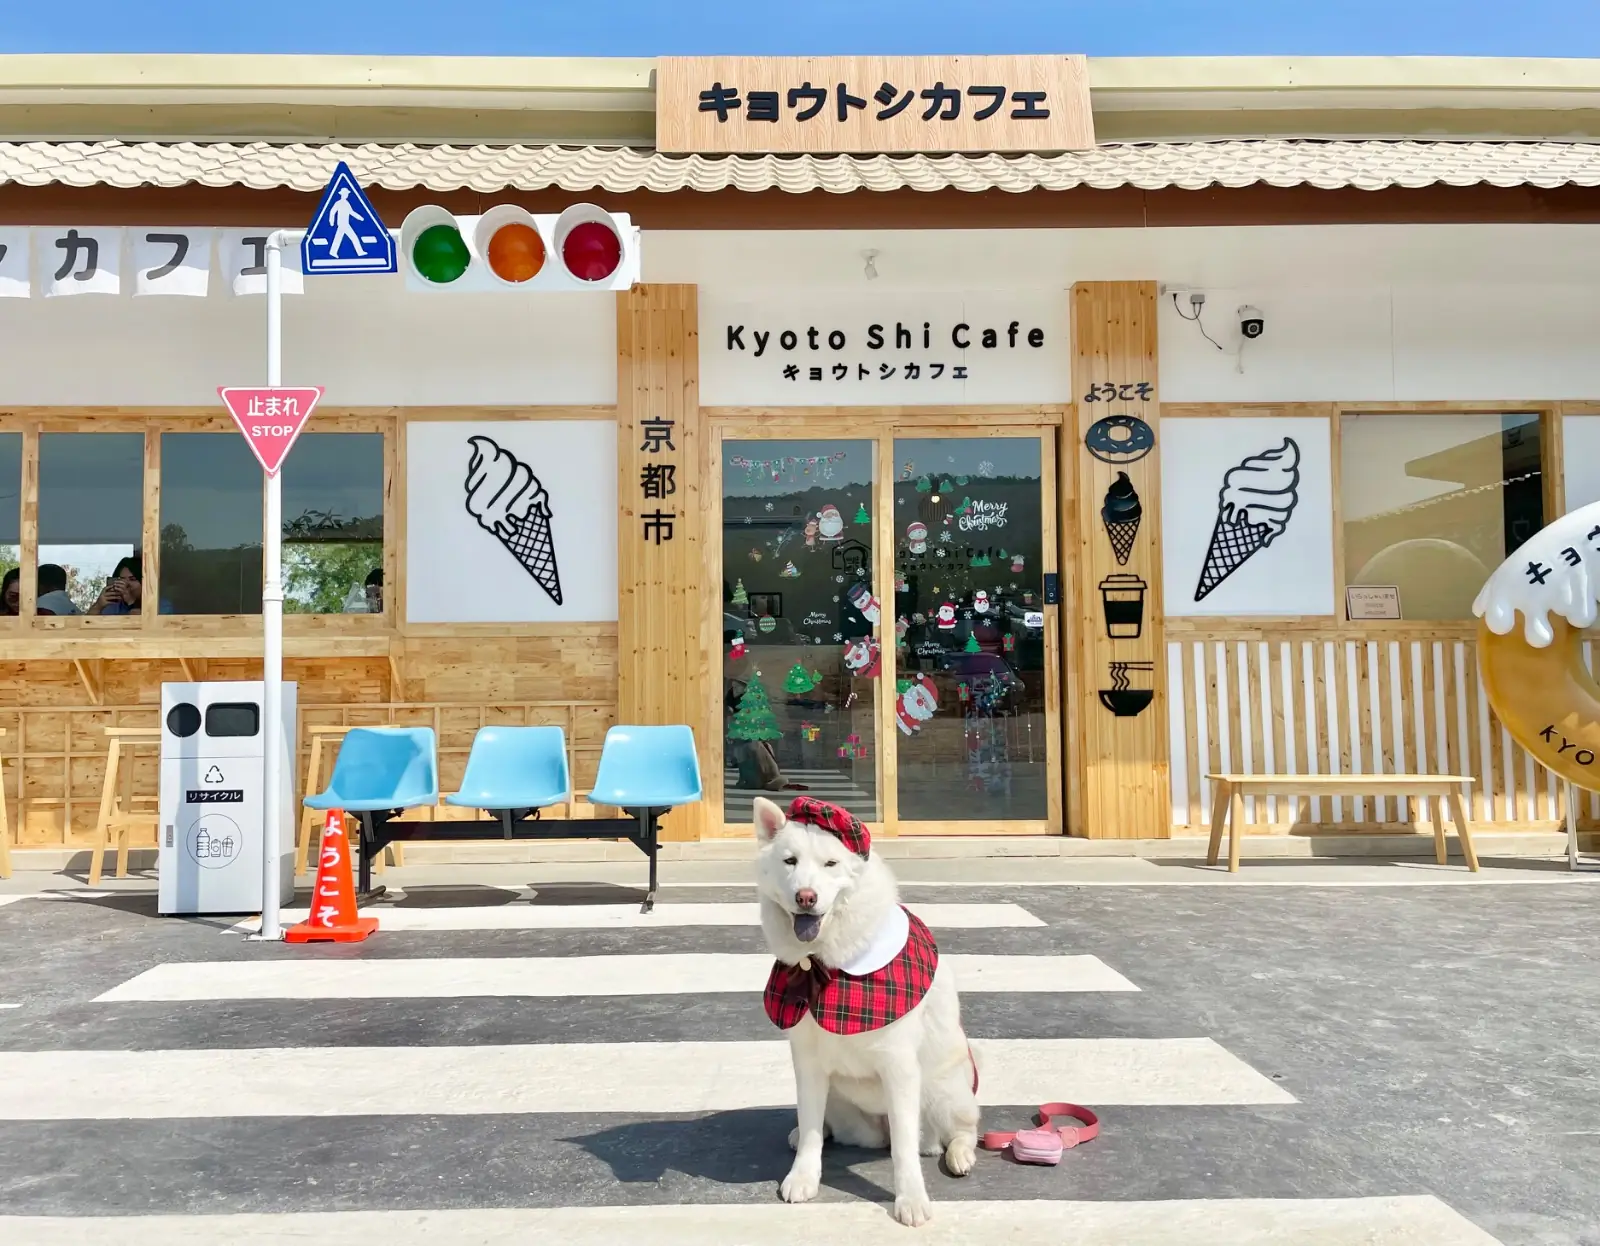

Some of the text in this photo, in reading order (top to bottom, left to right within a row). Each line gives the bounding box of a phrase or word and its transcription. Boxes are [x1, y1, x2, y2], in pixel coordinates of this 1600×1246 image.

[698, 82, 1051, 122] キョウトシカフェ
[0, 229, 268, 281] カフェ
[726, 321, 1045, 357] Kyoto Shi Cafe
[783, 362, 968, 381] キョウトシカフェ
[1084, 382, 1154, 403] ようこそ
[246, 396, 300, 417] 止まれ
[251, 425, 294, 437] STOP
[640, 416, 676, 545] 京都市
[972, 500, 1009, 516] Merry
[959, 511, 1008, 531] Christmas
[1539, 724, 1595, 766] KYO
[189, 790, 241, 802] リサイクル
[316, 816, 343, 928] ようこそ
